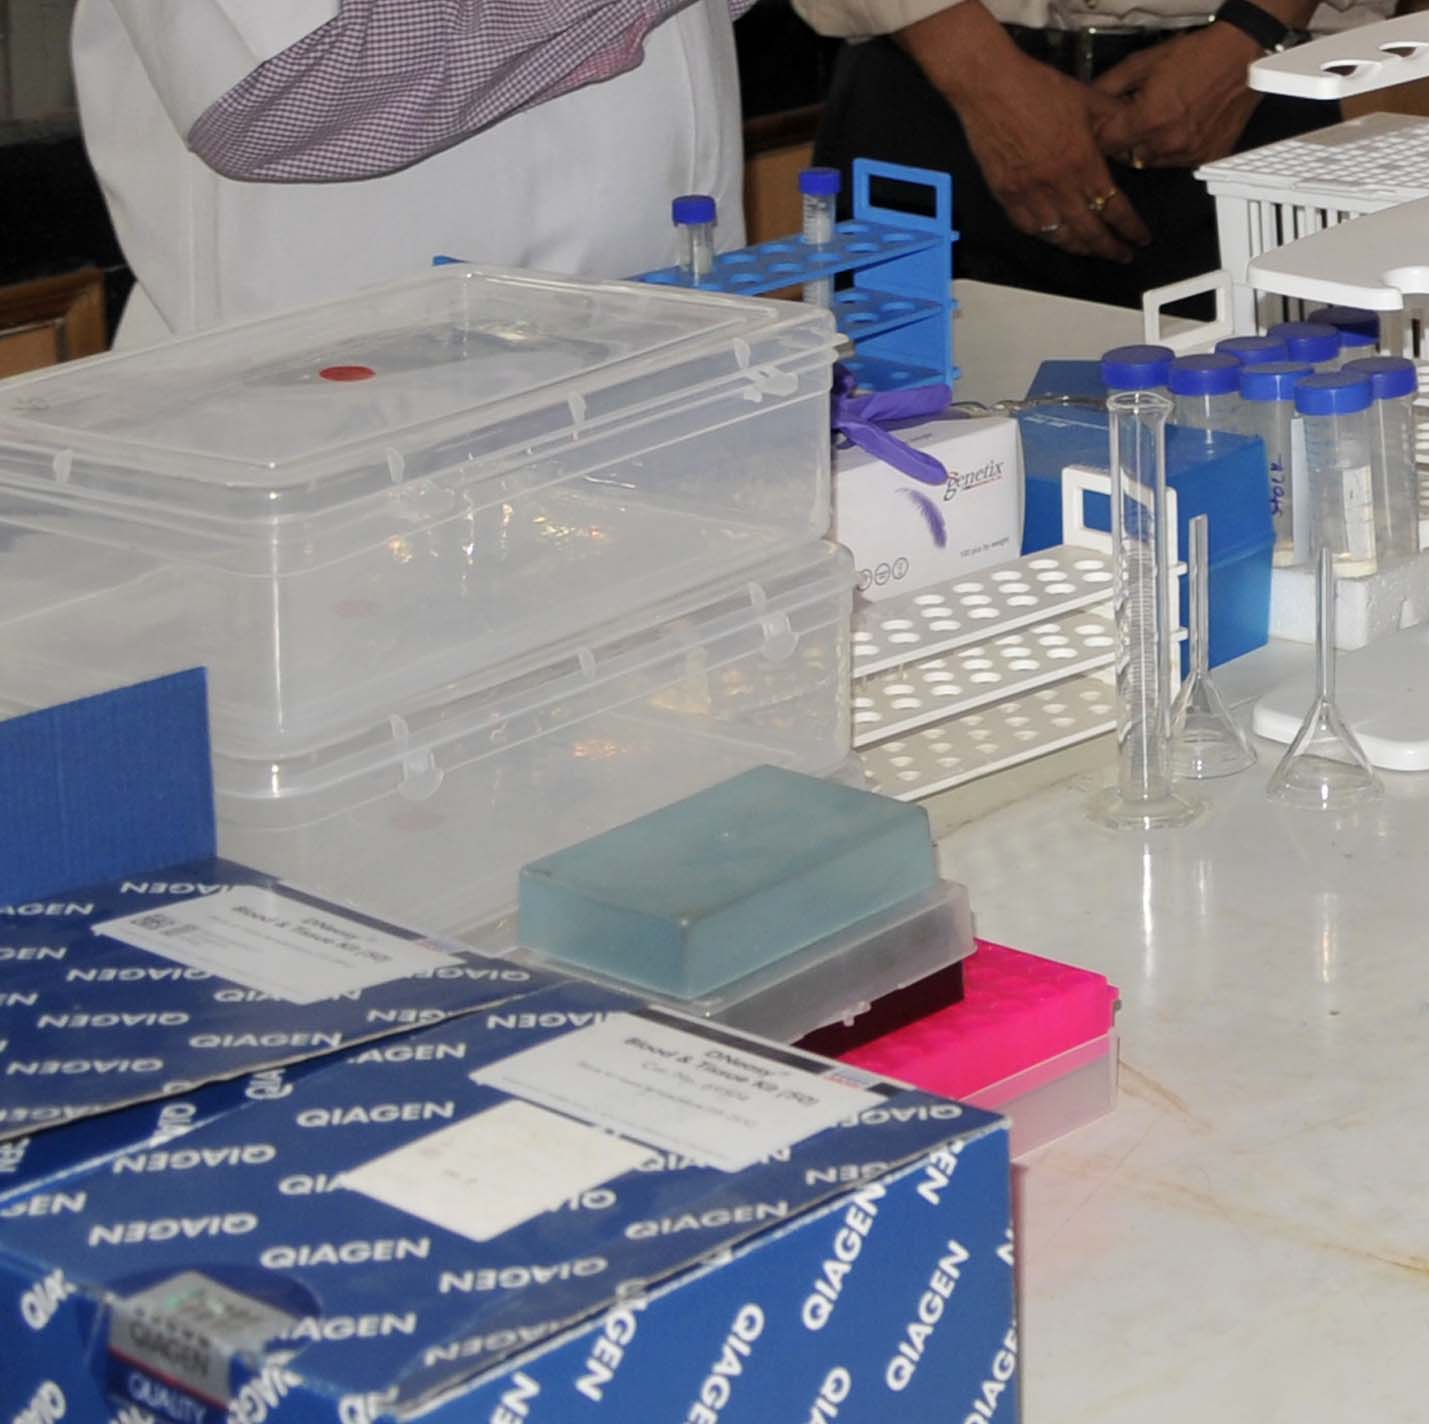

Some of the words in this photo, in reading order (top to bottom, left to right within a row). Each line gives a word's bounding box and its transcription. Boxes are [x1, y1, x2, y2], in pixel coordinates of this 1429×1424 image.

[944, 459, 1005, 502] genetix
[37, 1011, 191, 1029] QIAGEN
[188, 1031, 344, 1049] QIAGEN
[6, 1057, 164, 1076] QIAGEN
[623, 1036, 680, 1058] Blood
[697, 1060, 750, 1083] Tissue
[295, 1101, 455, 1128] QIAGEN
[112, 1143, 277, 1174] QIAGEN
[88, 1212, 259, 1247] QIAGEN
[624, 1200, 788, 1241] QIAGEN
[259, 1237, 431, 1270] QIAGEN
[438, 1257, 608, 1294] QIAGEN
[886, 1238, 970, 1392] QIAGEN
